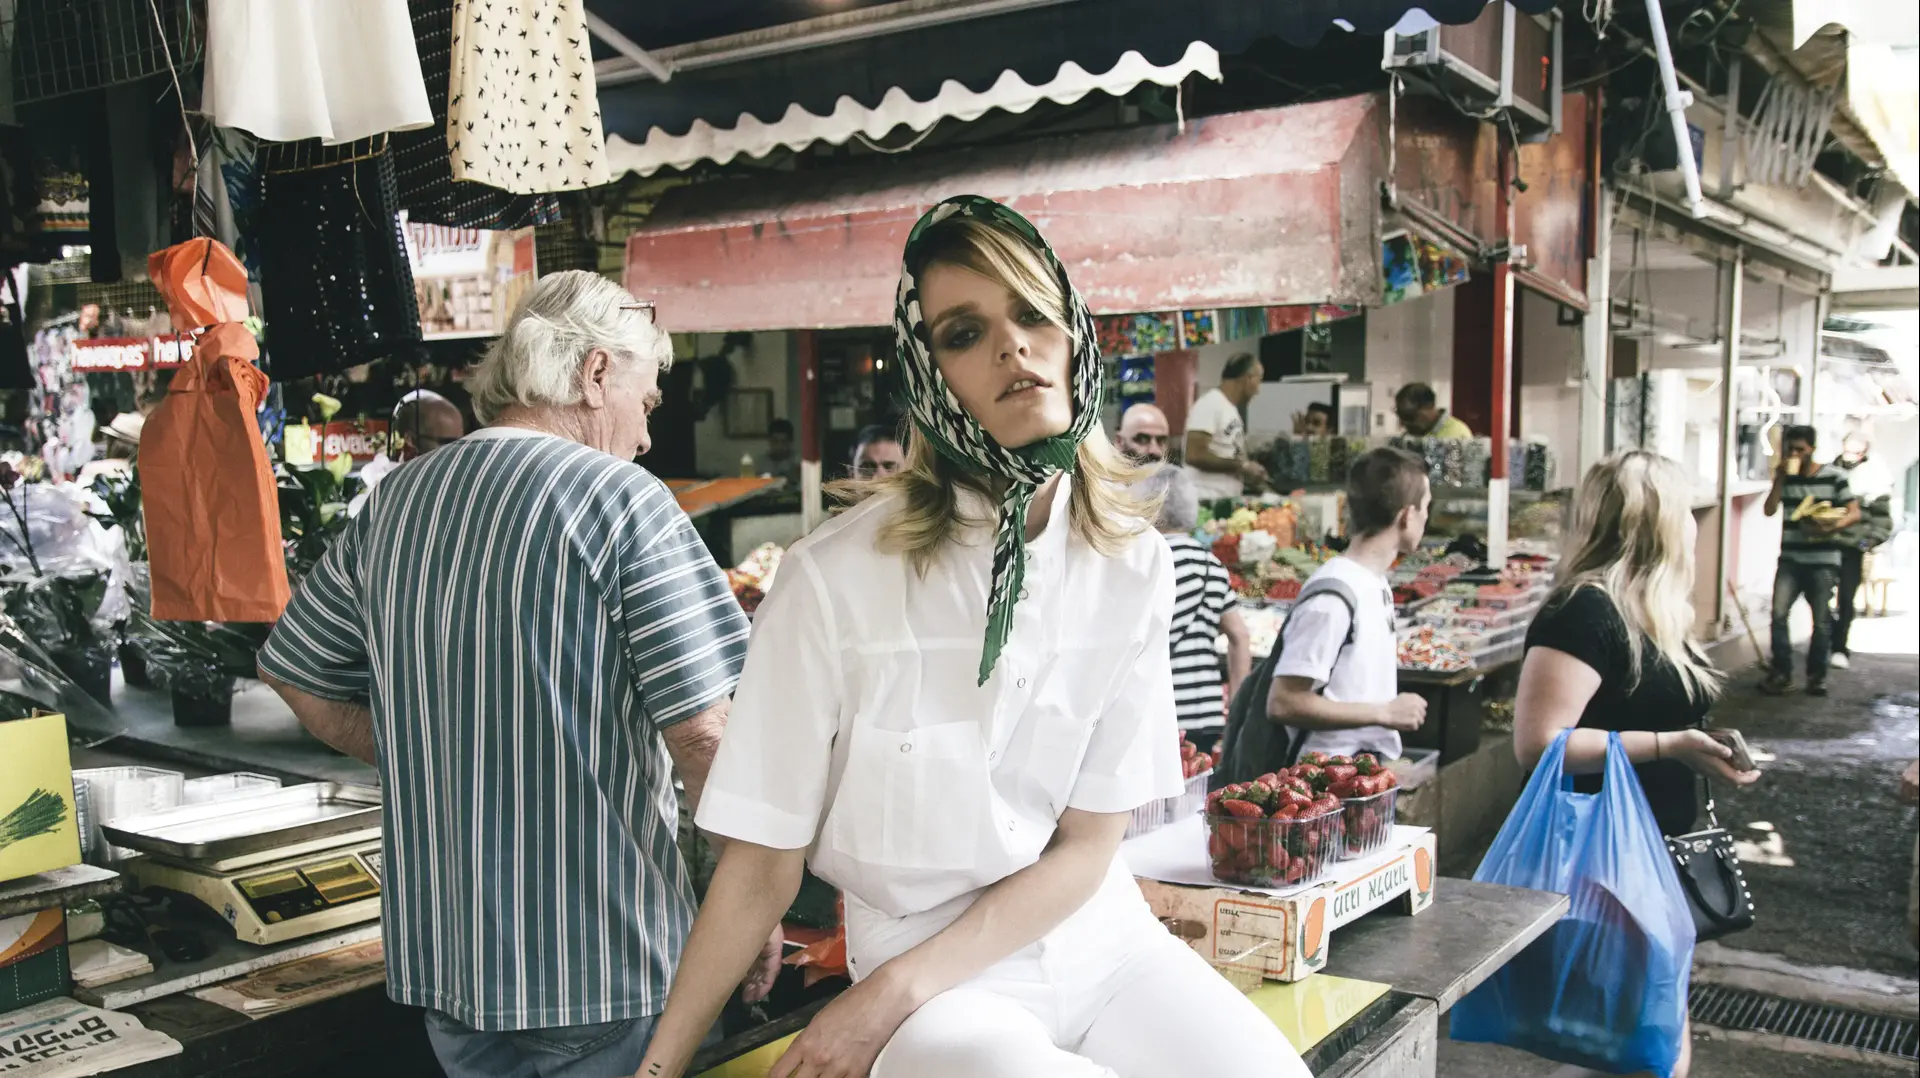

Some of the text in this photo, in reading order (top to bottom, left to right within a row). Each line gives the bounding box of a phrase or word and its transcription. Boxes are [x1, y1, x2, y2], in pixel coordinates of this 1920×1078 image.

[1334, 864, 1408, 918] מנגו אלמגור
[20, 1029, 121, 1063] גברים
